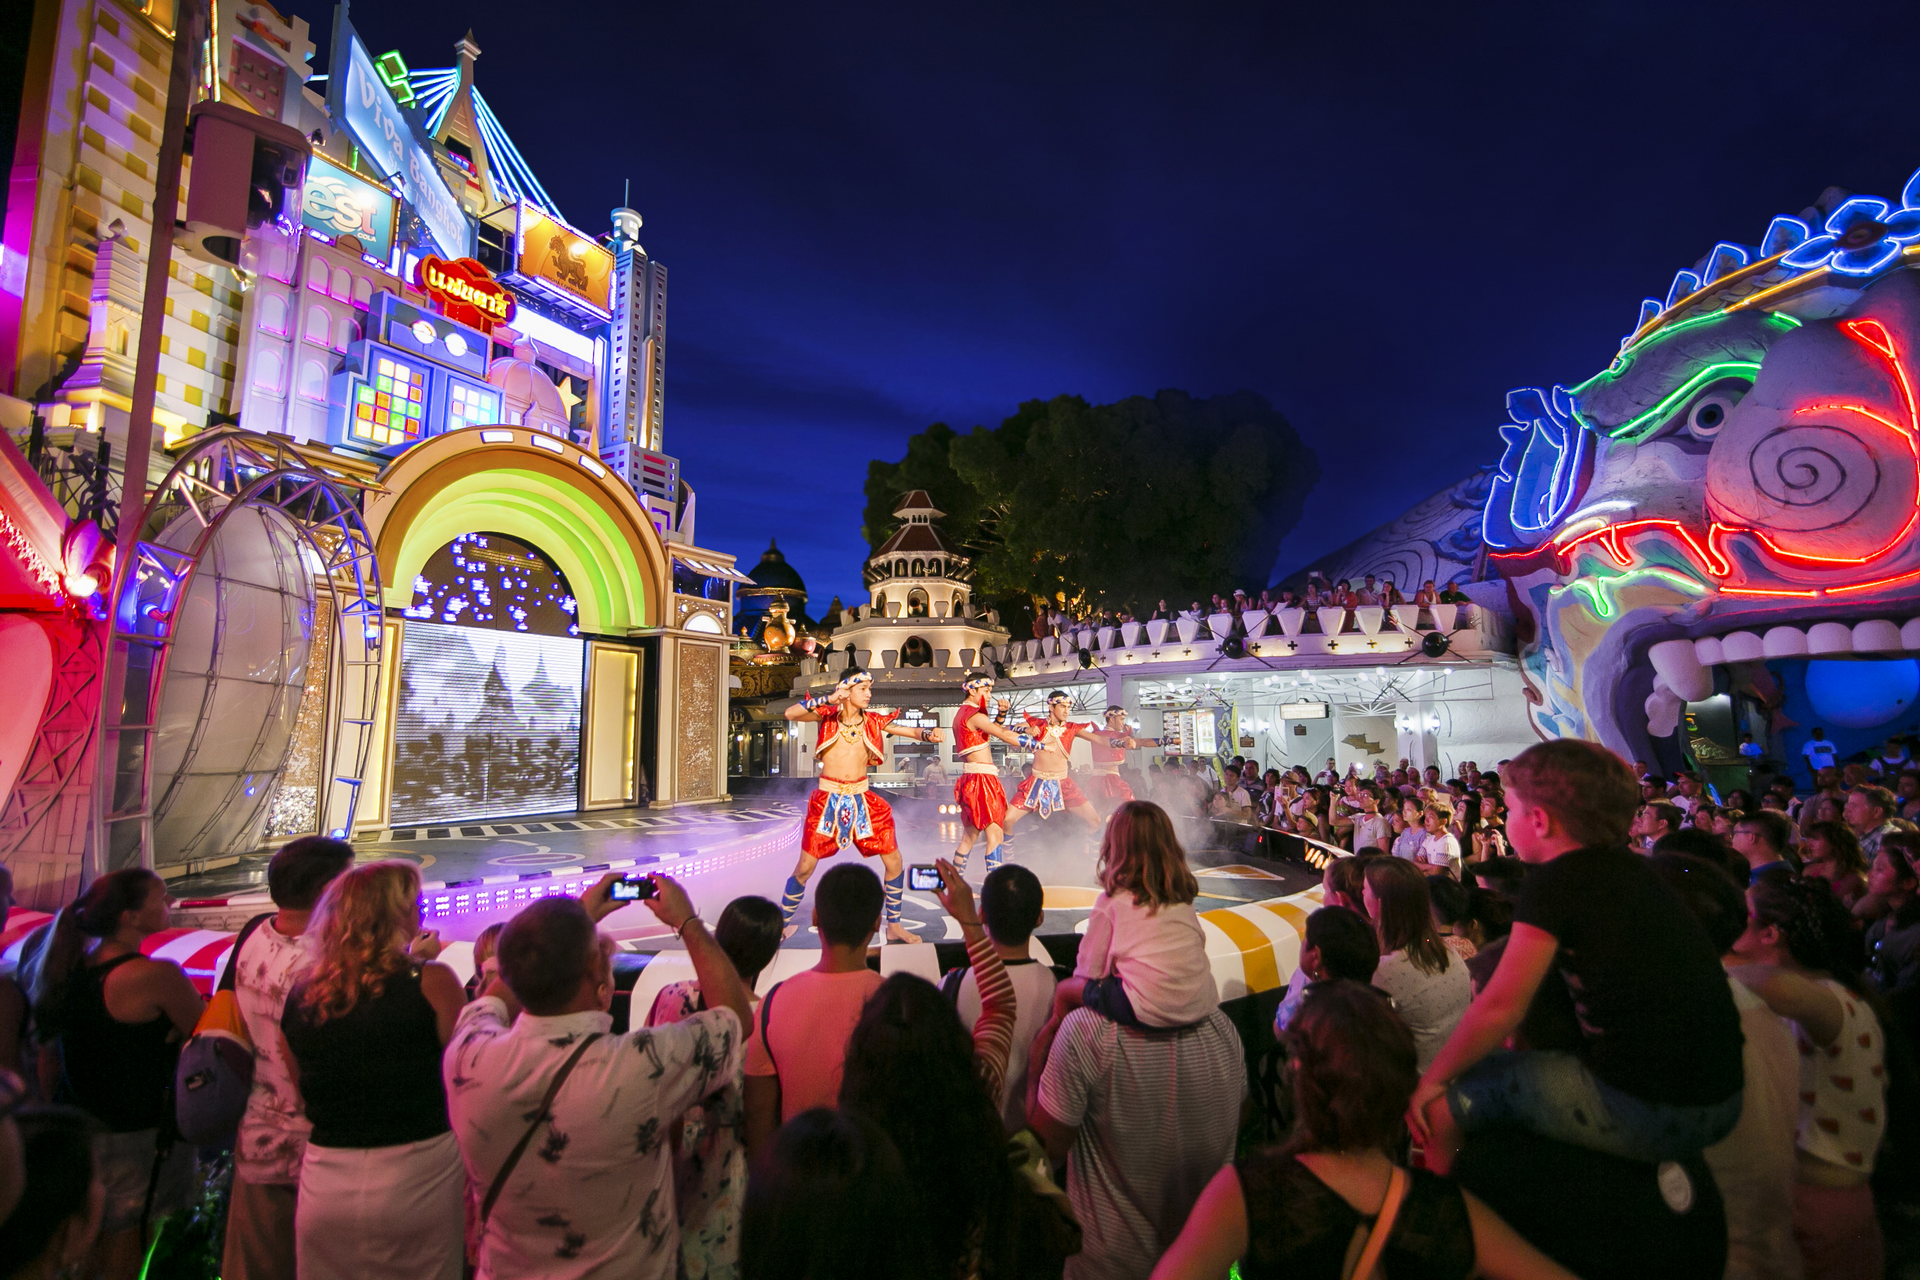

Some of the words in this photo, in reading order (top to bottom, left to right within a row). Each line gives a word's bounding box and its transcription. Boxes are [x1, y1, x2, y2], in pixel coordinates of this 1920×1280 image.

[356, 61, 403, 161] Viva
[409, 147, 463, 254] Bangkok
[302, 181, 377, 235] est
[387, 150, 412, 193] Ste
[414, 188, 444, 236] Theater
[357, 232, 376, 242] COLA
